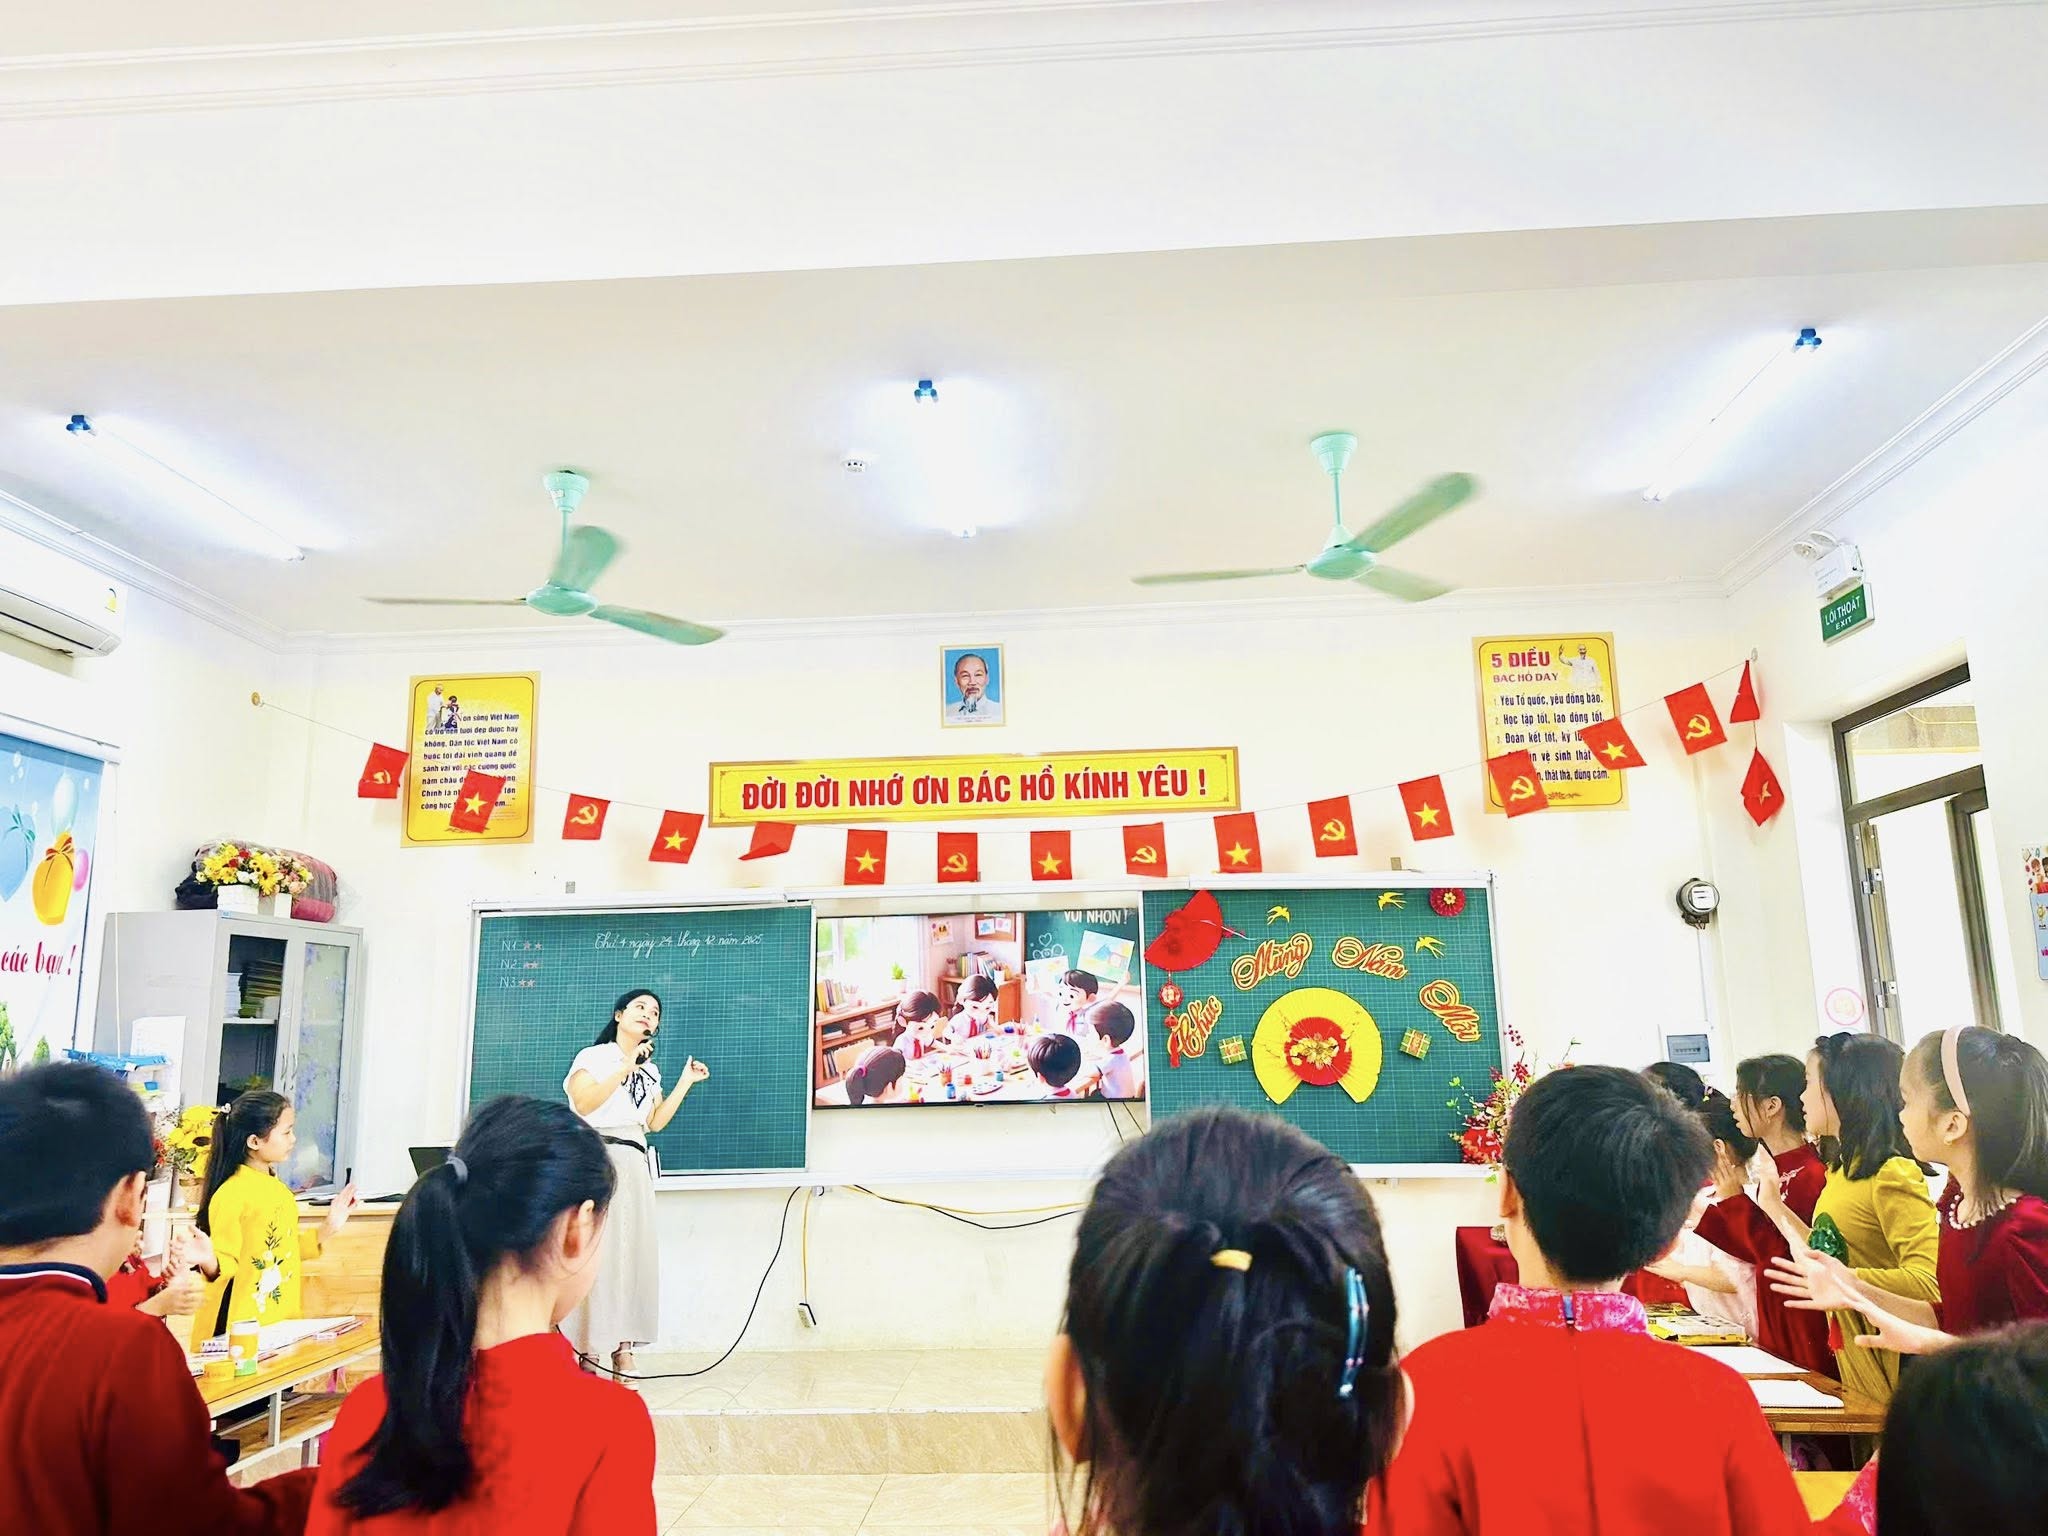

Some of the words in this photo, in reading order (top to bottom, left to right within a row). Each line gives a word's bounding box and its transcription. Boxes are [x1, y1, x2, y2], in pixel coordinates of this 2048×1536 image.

[1837, 595, 1860, 618] THOÁT
[1835, 615, 1852, 630] EXIT
[1491, 653, 1502, 668] 5
[1508, 646, 1551, 668] ĐIỀU
[504, 712, 520, 720] Nam
[1554, 712, 1566, 723] lao
[506, 725, 519, 733] hay
[491, 737, 508, 746] Nam
[467, 750, 483, 758] vinh
[1554, 750, 1572, 762] sinh
[742, 776, 787, 810] ĐỜI
[795, 774, 840, 809] ĐỜI
[849, 773, 904, 807] NHỚ
[912, 775, 949, 805] ƠN
[958, 769, 1012, 803] BÁC
[1020, 764, 1056, 802] HỒ
[1064, 766, 1129, 800] KÍNH
[1137, 764, 1189, 798] YÊU
[1063, 909, 1083, 923] VUI
